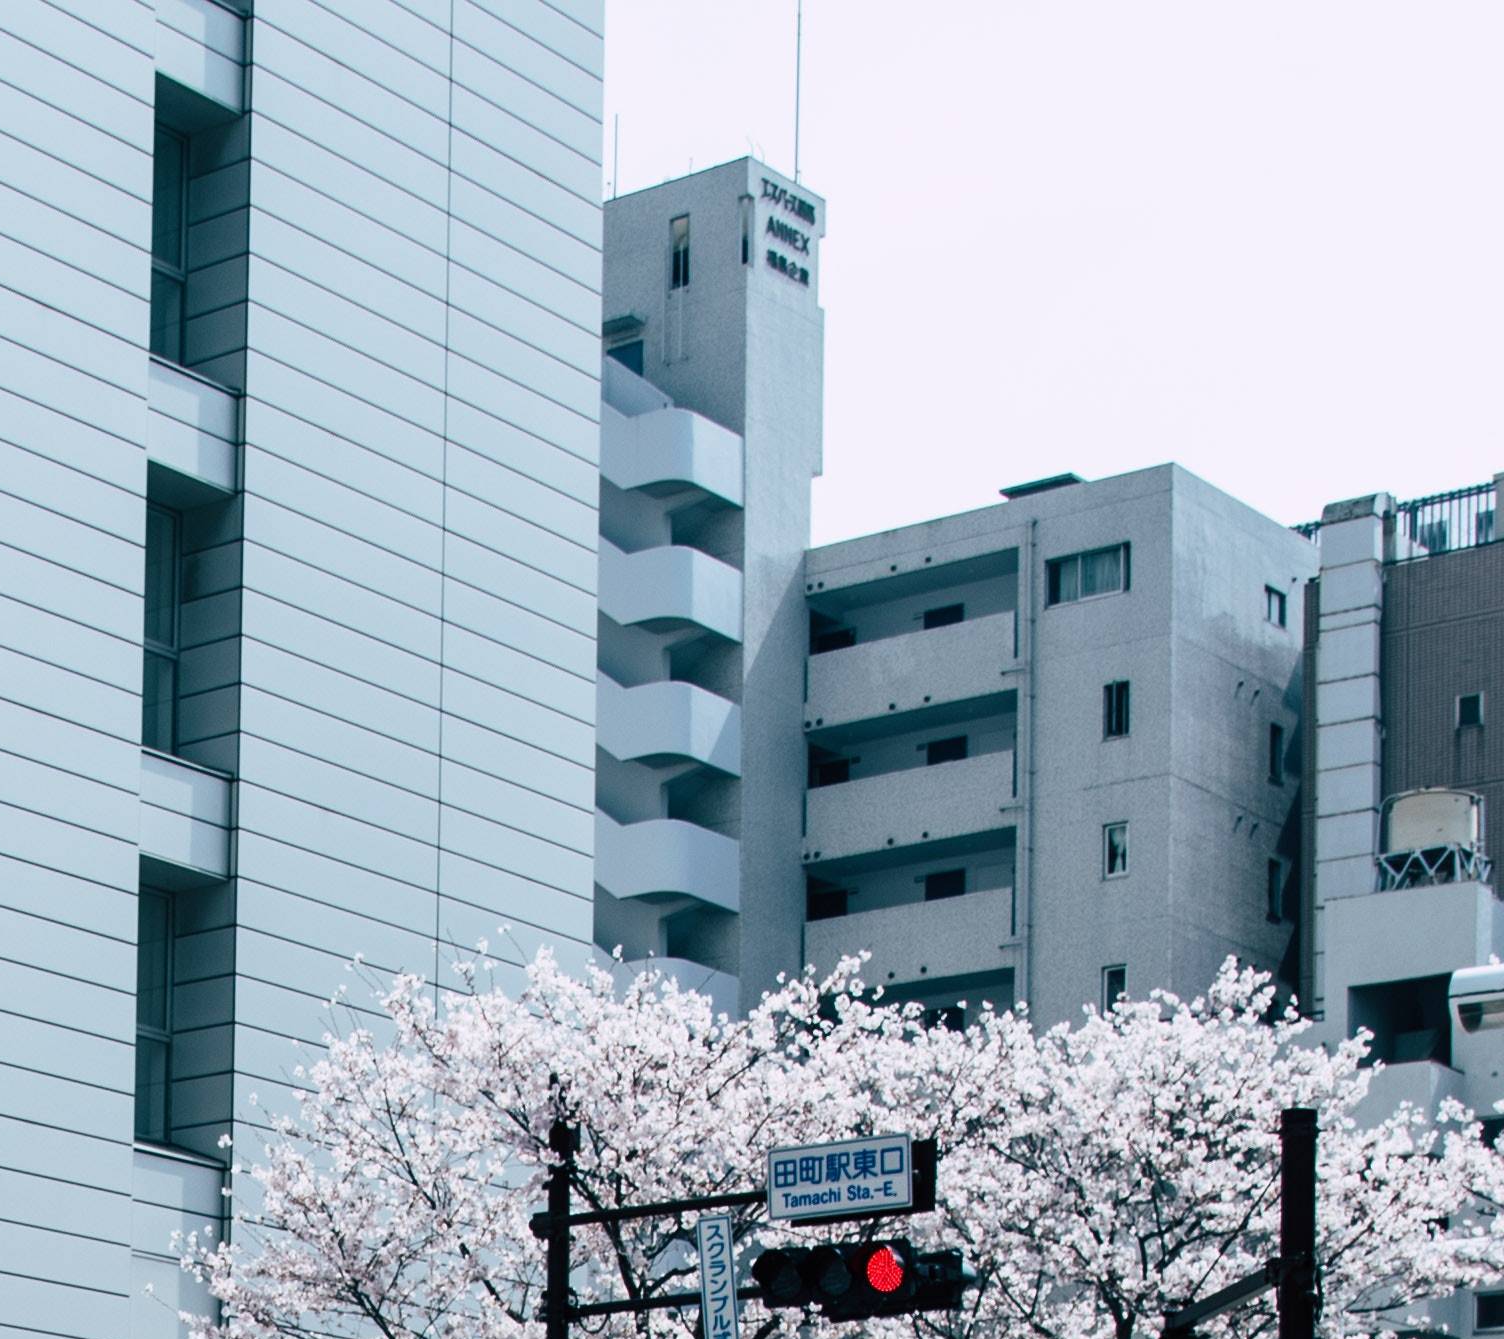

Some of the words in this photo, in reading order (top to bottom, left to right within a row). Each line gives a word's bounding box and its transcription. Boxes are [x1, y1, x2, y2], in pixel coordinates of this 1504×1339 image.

[766, 216, 810, 256] ANNEX
[774, 1147, 904, 1188] 田町駅東口
[782, 1188, 841, 1208] Tamachi
